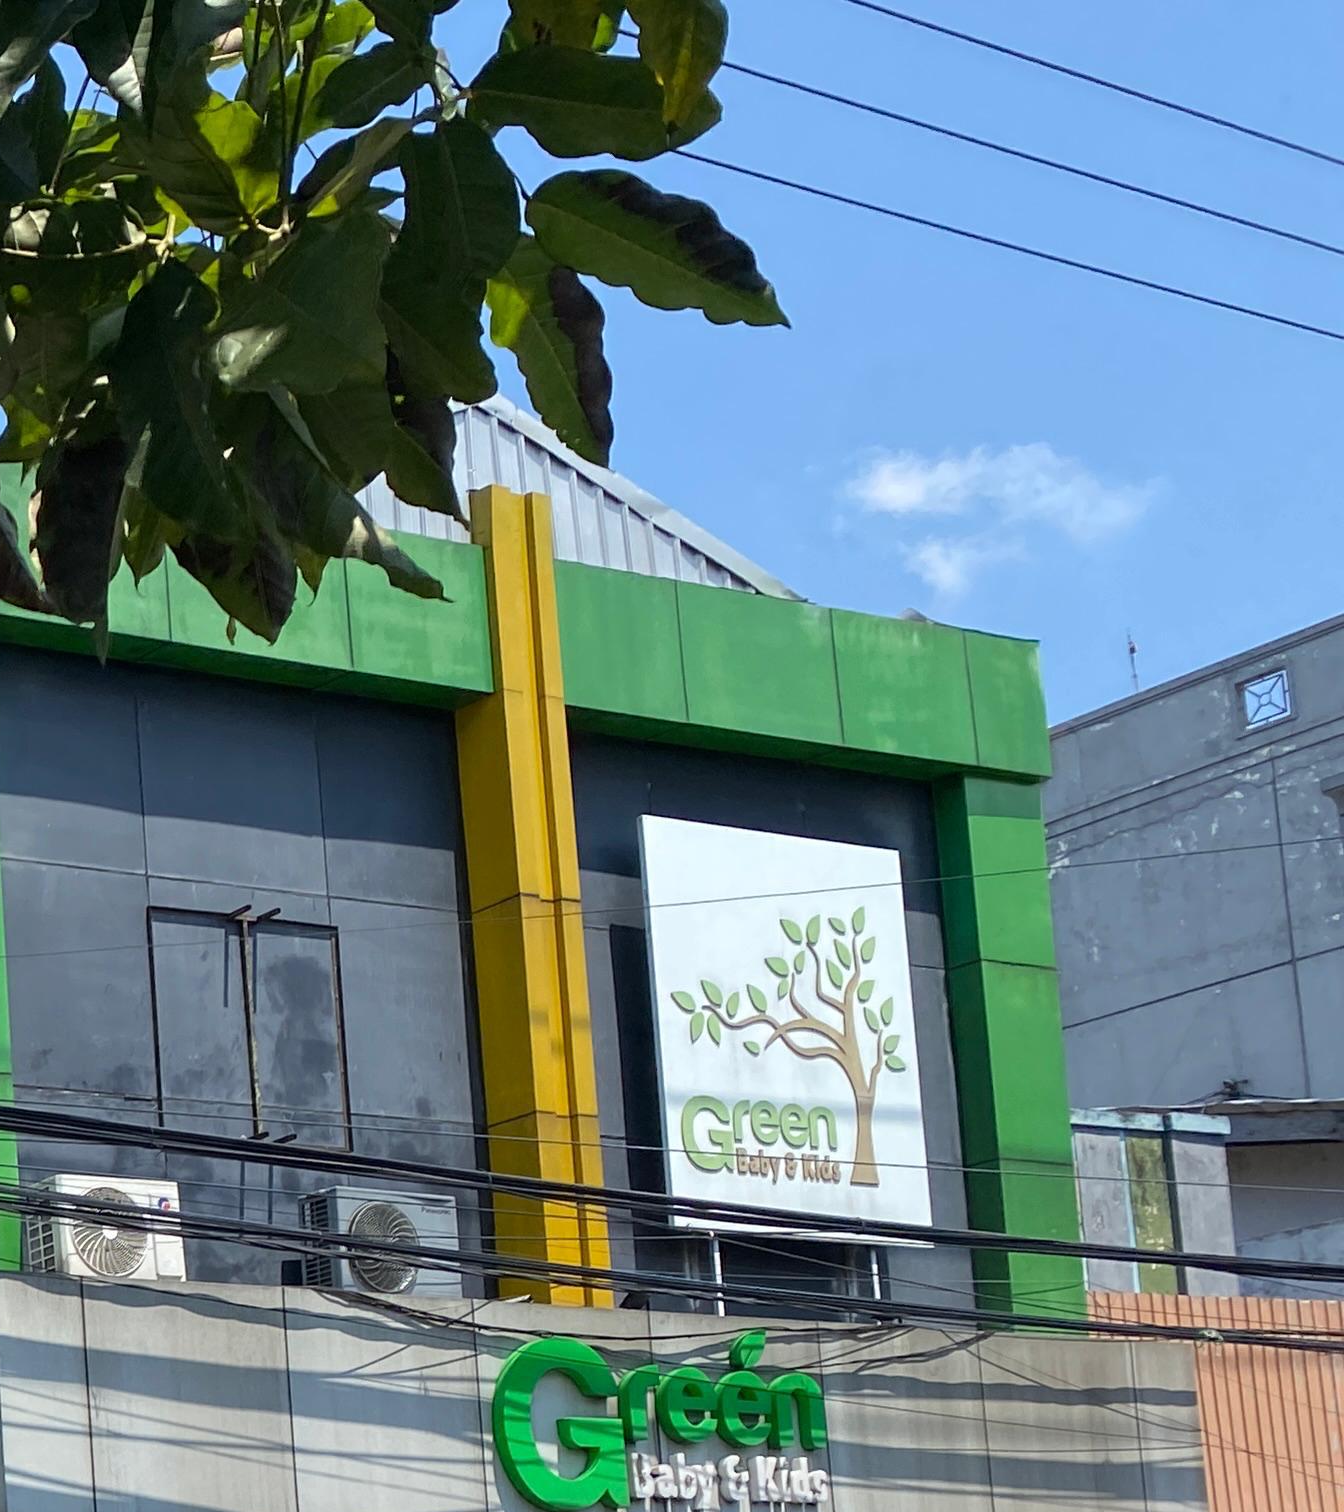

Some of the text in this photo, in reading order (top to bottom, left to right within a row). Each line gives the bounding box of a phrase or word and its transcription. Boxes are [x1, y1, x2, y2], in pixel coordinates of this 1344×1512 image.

[680, 1095, 838, 1174] Green
[735, 1147, 843, 1185] Baby & Kids
[493, 1334, 829, 1512] Green
[719, 1454, 750, 1502] &
[749, 1454, 829, 1503] Kids
